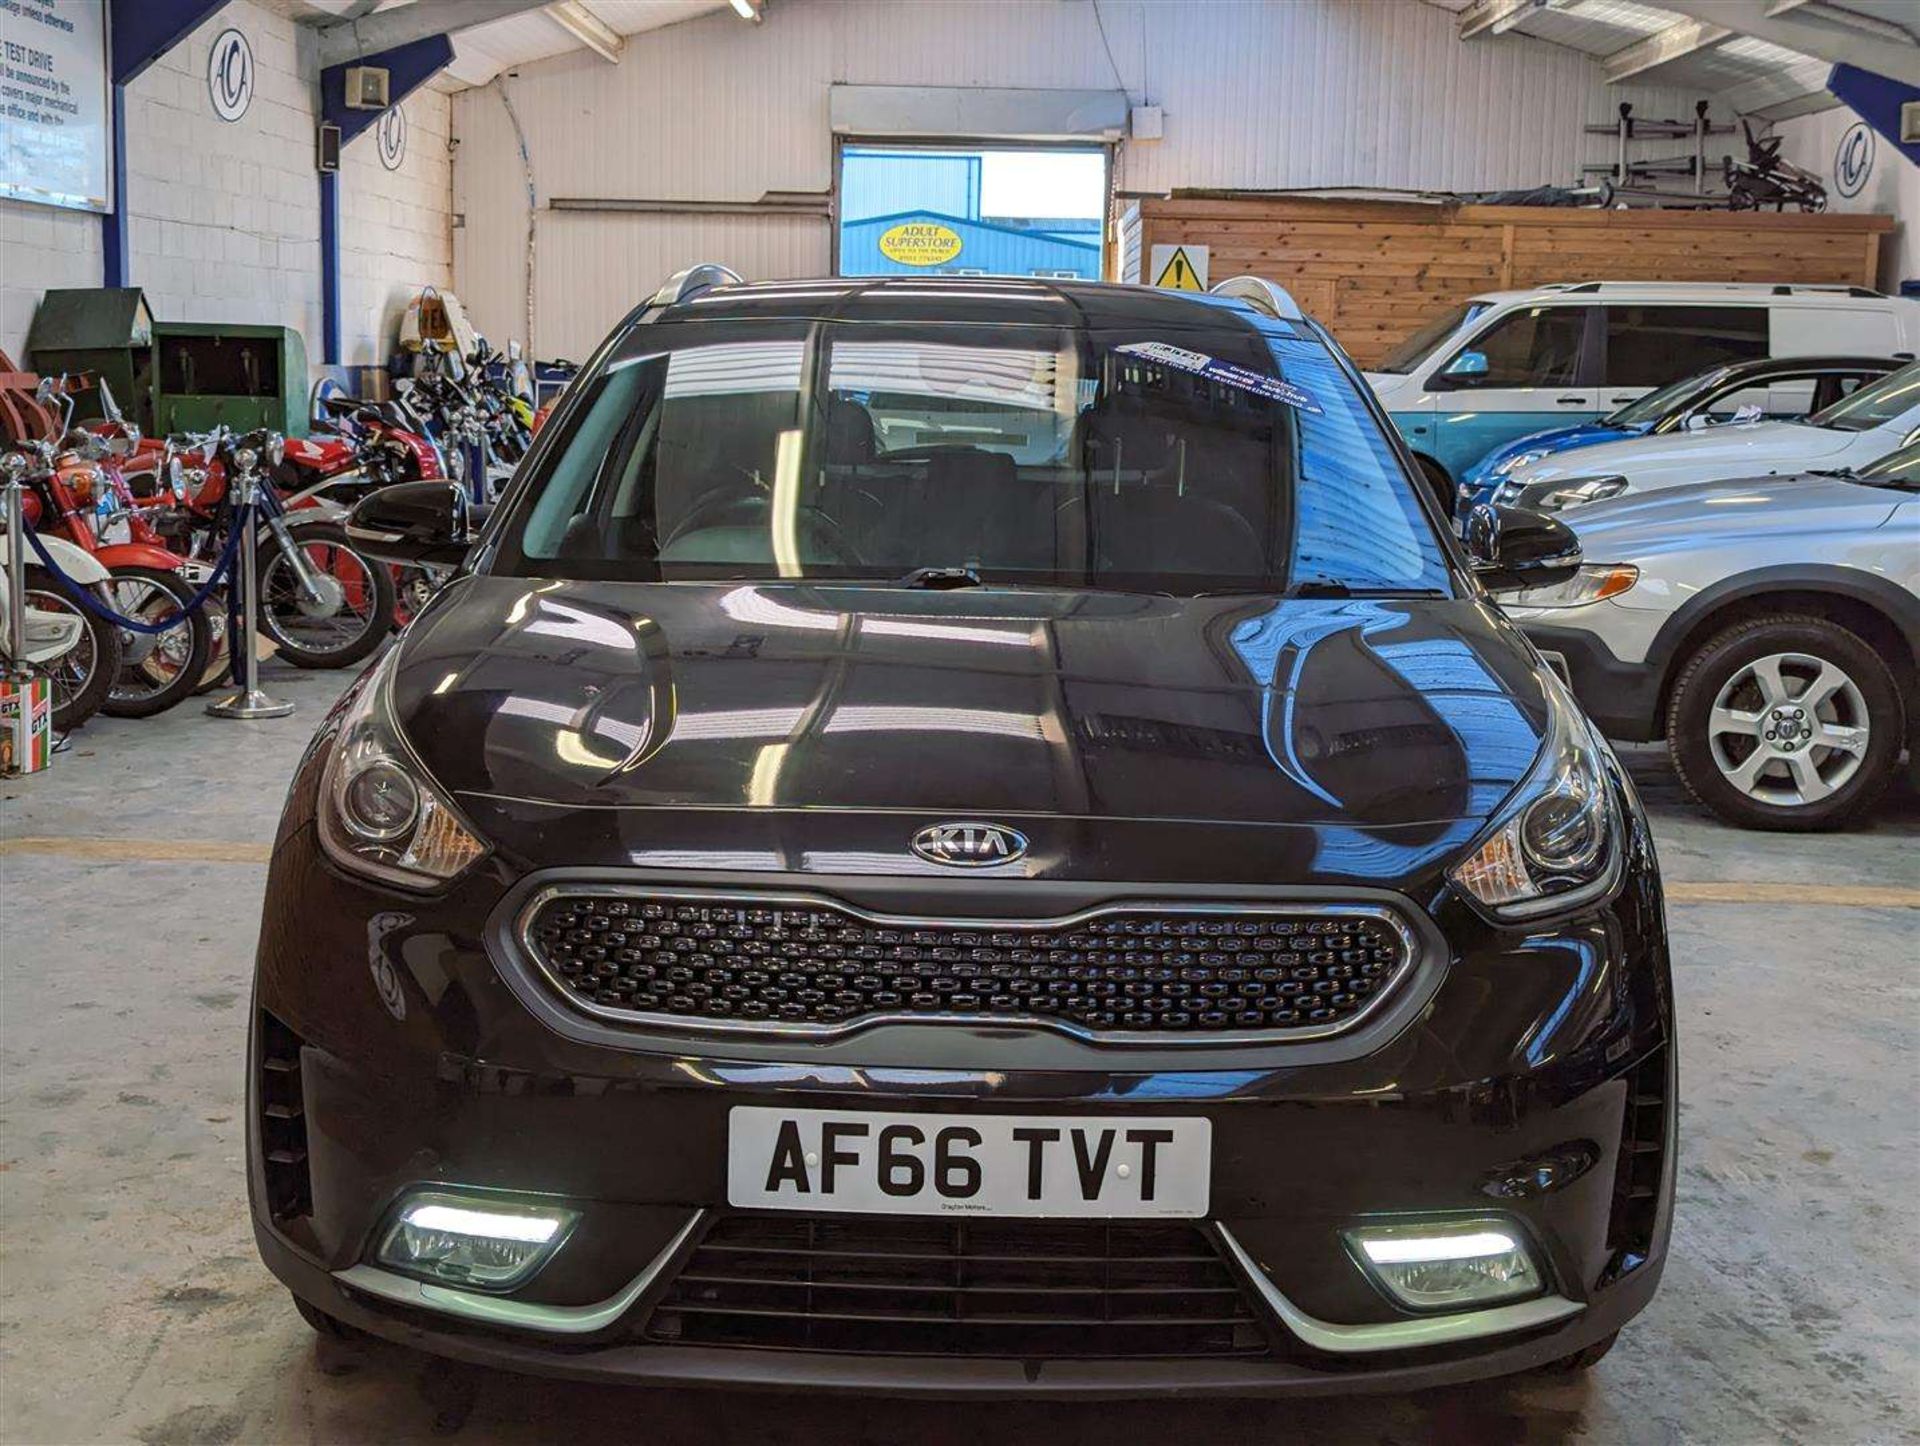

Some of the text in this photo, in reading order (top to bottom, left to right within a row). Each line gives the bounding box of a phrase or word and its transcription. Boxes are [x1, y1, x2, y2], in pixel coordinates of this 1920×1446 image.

[4, 41, 26, 64] TEST
[28, 48, 53, 72] DRIVE
[2, 85, 23, 101] covers
[901, 226, 939, 237] ADULT
[886, 237, 957, 248] SUPERSTORE
[2, 702, 20, 713] GTX
[32, 711, 48, 734] GTX
[931, 828, 1009, 855] KIA
[765, 1119, 1174, 1201] AF66 TVT
